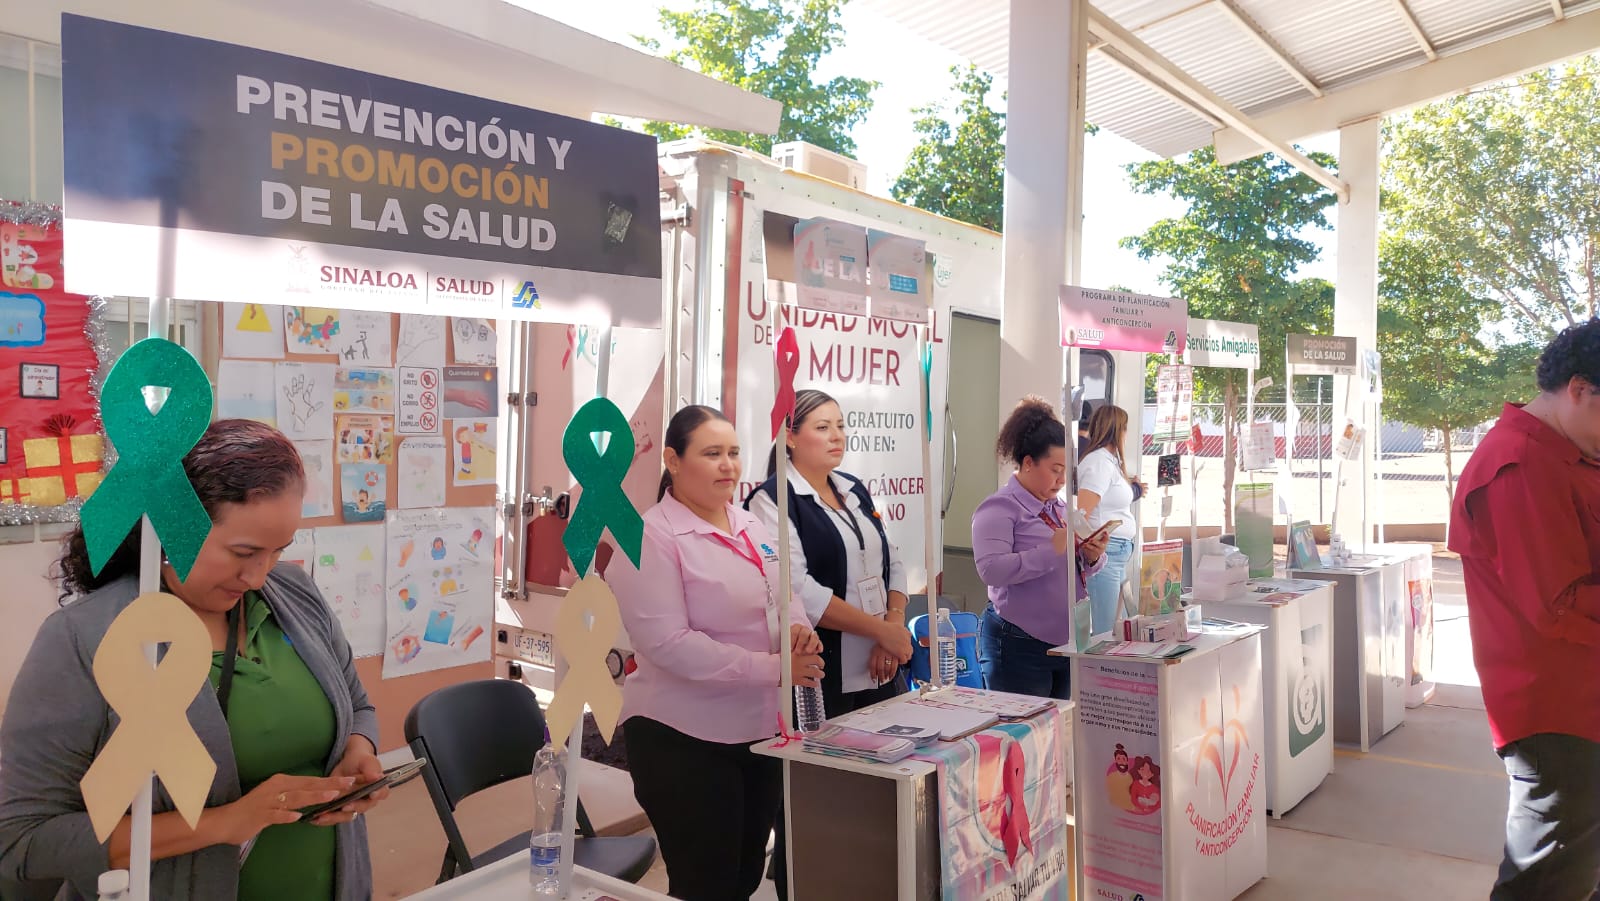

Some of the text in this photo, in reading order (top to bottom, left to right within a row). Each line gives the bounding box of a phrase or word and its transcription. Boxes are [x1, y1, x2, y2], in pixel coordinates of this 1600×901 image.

[236, 74, 572, 170] PREVENCIÓN Y
[271, 131, 549, 209] PROMOCIÓN
[261, 180, 557, 252] DE LA SALUD
[320, 265, 494, 296] SINALOA SALUD
[1081, 291, 1116, 301] PROGRAMA
[1127, 297, 1170, 308] PLANIFICACIÓN
[1112, 306, 1141, 315] FAMILIAR
[1078, 328, 1104, 340] SALUD
[1186, 333, 1258, 357] Servicios Amigables
[1303, 339, 1346, 350] PROMOCIÓN
[809, 341, 901, 386] MUJER
[1303, 350, 1346, 361] DE LA SALUD
[847, 411, 914, 429] GRATUITO
[874, 436, 895, 452] EN:
[867, 473, 924, 496] CÁNCER
[1237, 753, 1259, 816] FAMILIAR
[1195, 837, 1201, 851] Y
